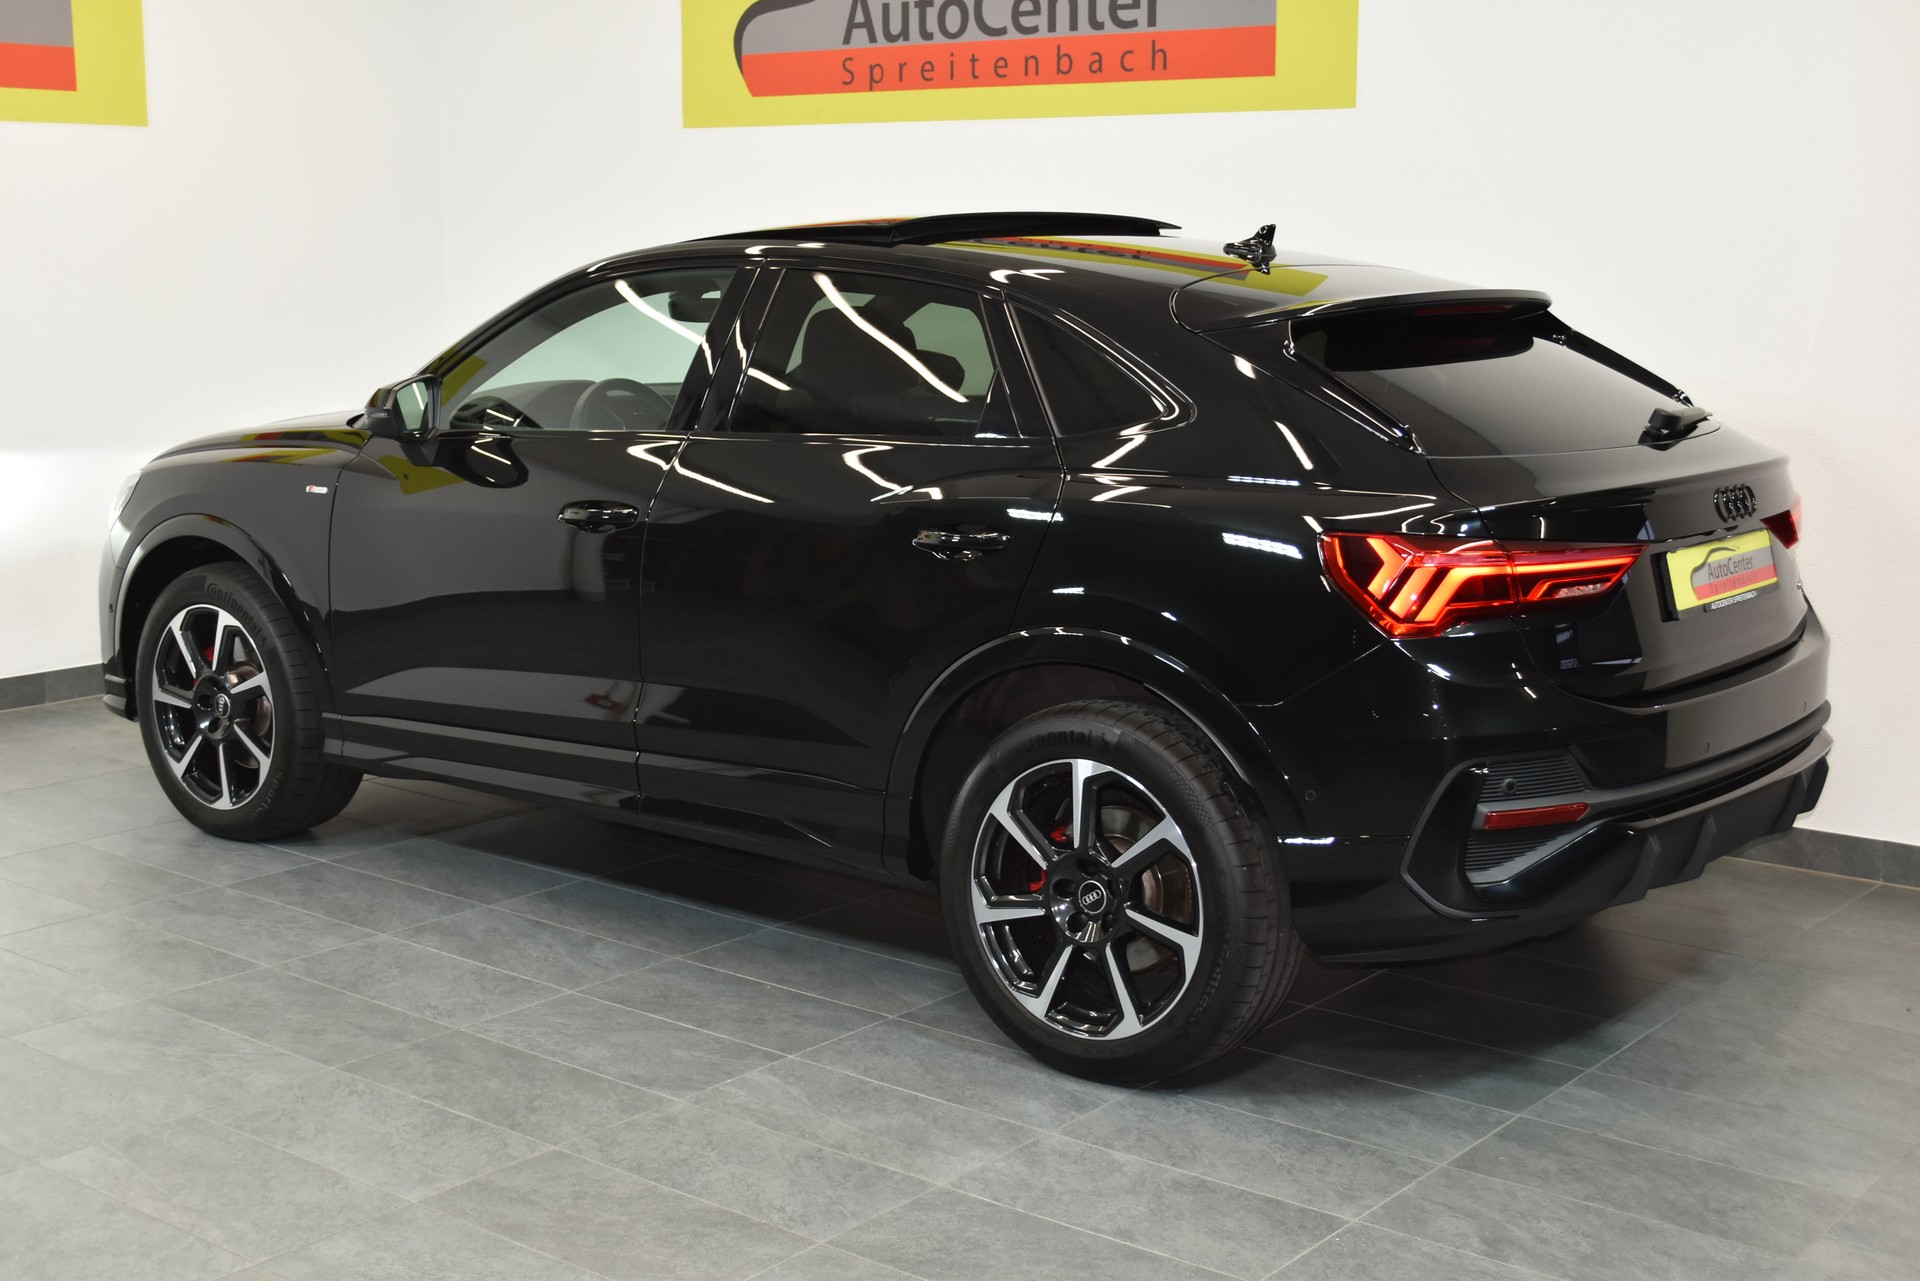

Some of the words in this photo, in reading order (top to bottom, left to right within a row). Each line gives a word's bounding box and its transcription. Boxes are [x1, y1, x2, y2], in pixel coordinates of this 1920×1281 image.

[841, 40, 1167, 92] Spreitenbach
[1708, 556, 1753, 581] AutoCenter
[207, 582, 262, 638] Continental
